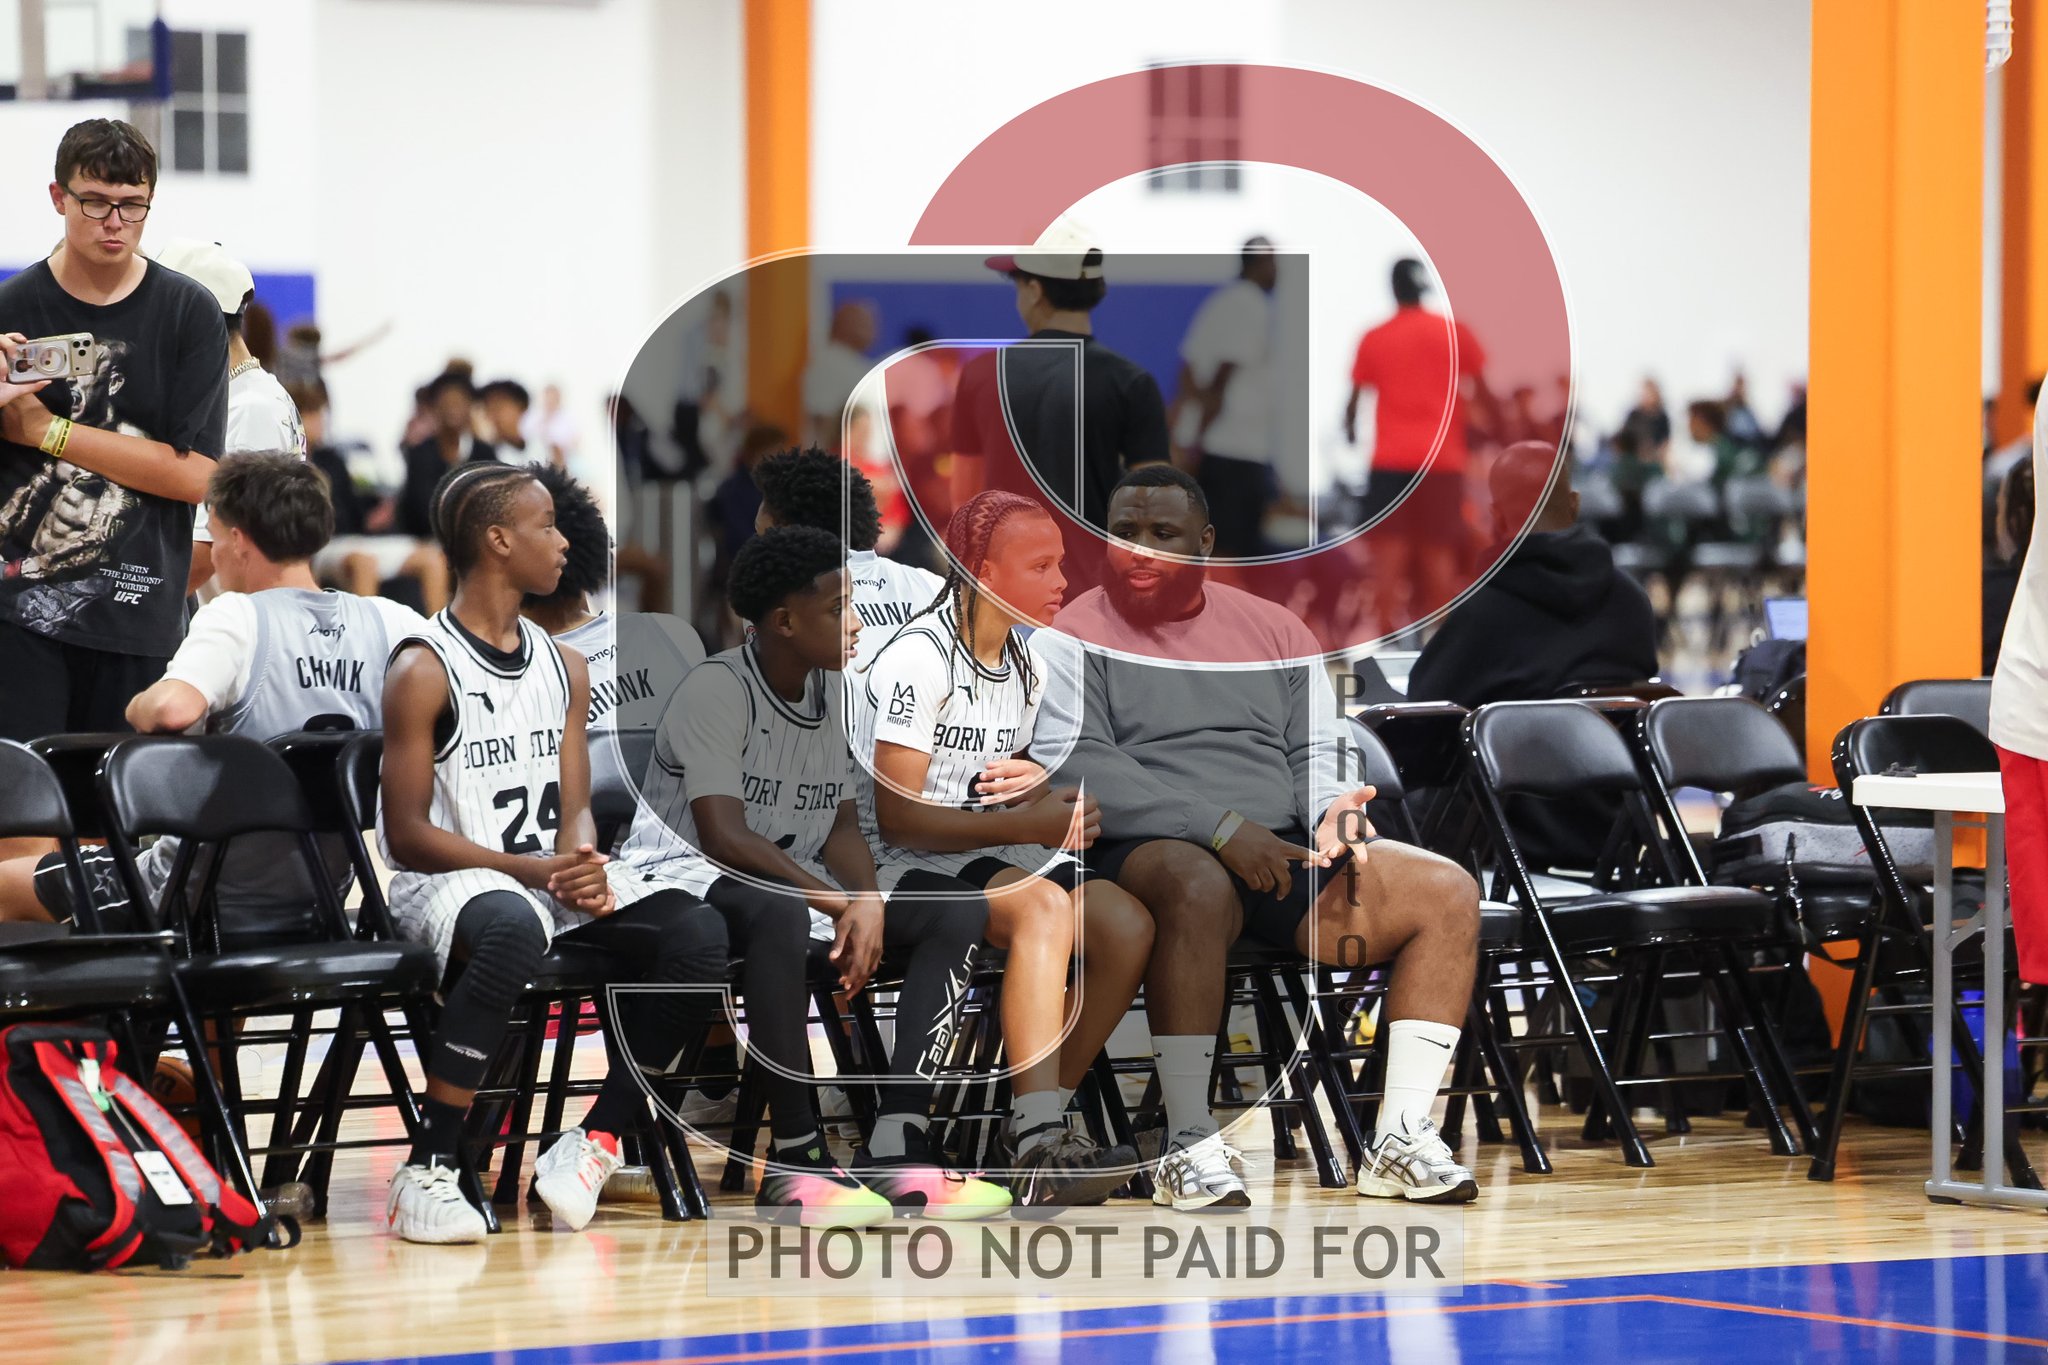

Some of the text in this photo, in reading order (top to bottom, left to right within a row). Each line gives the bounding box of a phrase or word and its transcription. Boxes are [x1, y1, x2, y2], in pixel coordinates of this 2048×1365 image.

[120, 562, 150, 574] DUSTIN
[114, 580, 150, 593] POIRIER
[113, 590, 142, 605] UFC
[854, 601, 912, 627] HUNK
[887, 715, 912, 728] HOOPS
[933, 723, 1020, 753] BORN STA
[742, 771, 844, 811] ORN STAR
[492, 781, 561, 855] 24
